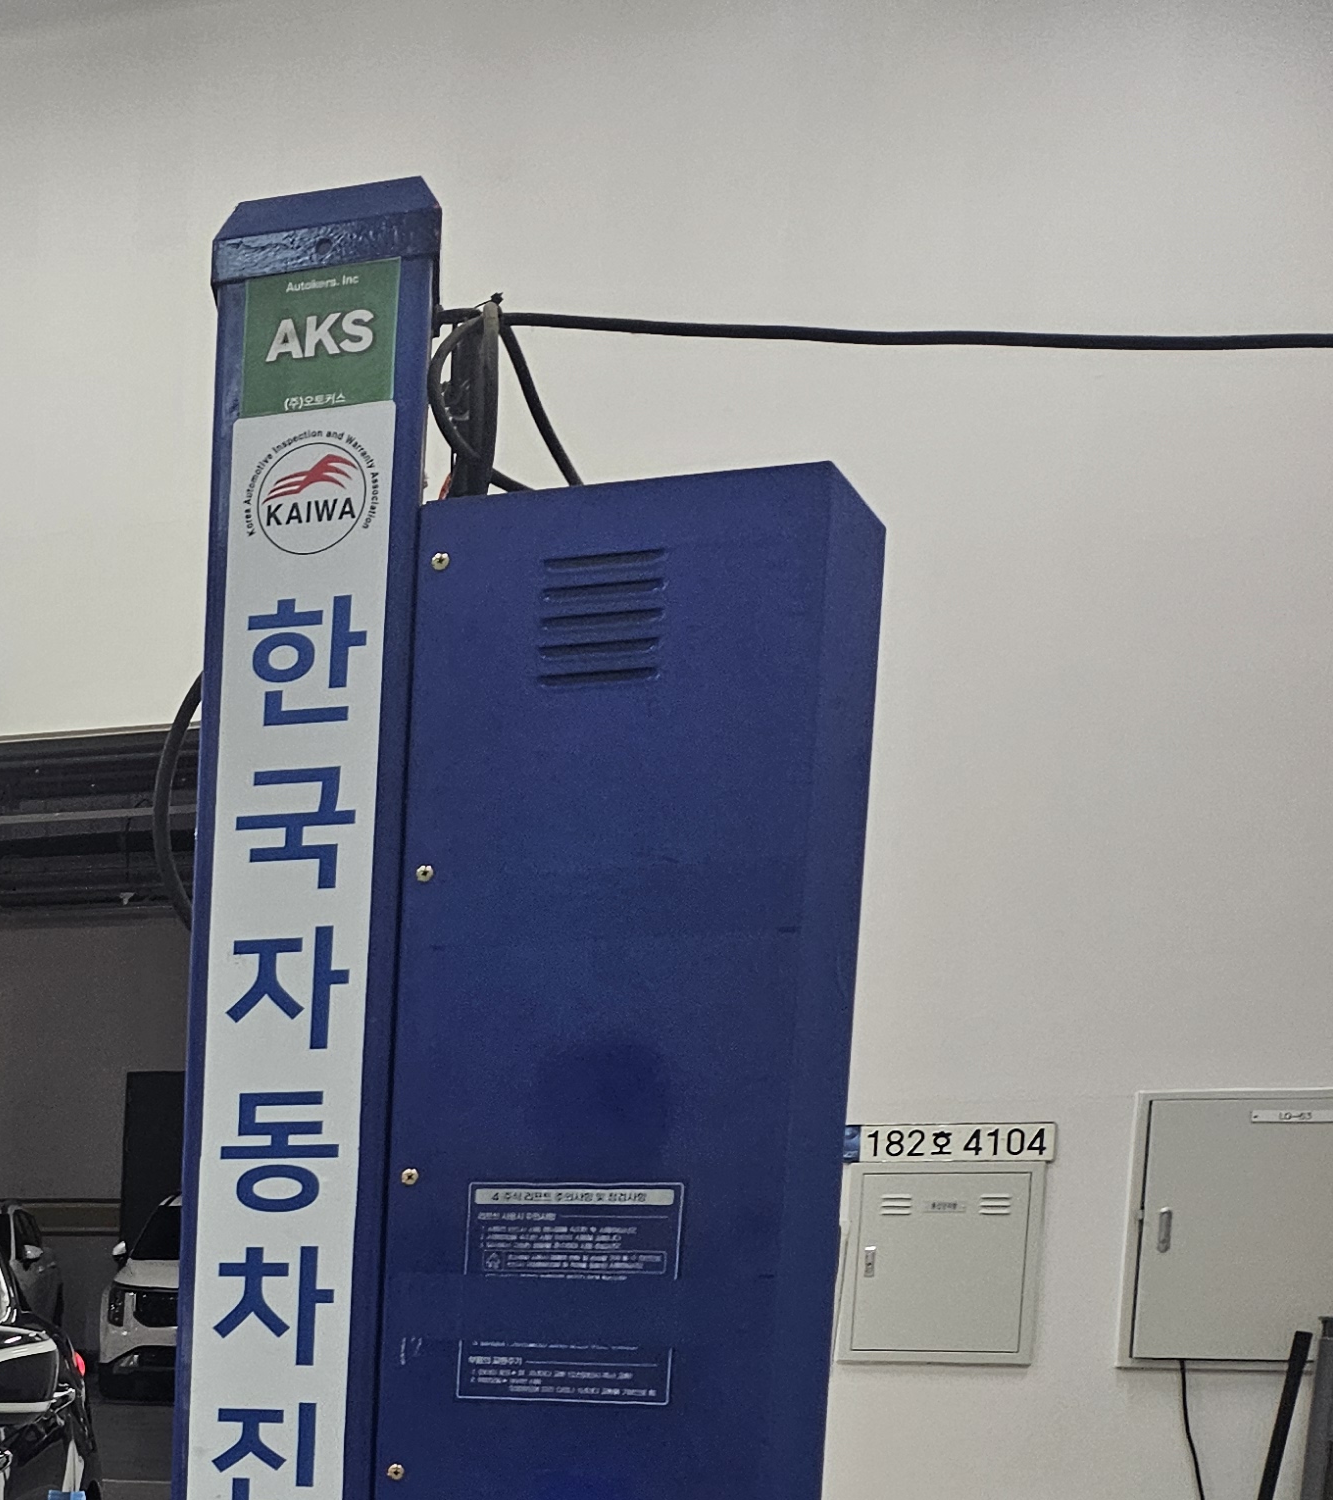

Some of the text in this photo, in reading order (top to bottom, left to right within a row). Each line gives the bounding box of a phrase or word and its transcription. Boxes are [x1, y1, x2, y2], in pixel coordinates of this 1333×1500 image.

[342, 275, 359, 286] Inc
[265, 309, 375, 363] AKS
[243, 429, 380, 538] Korea Automotive Inspection and Warranty Association
[266, 497, 356, 527] KAIWA
[867, 1128, 1047, 1157] 182호 4104
